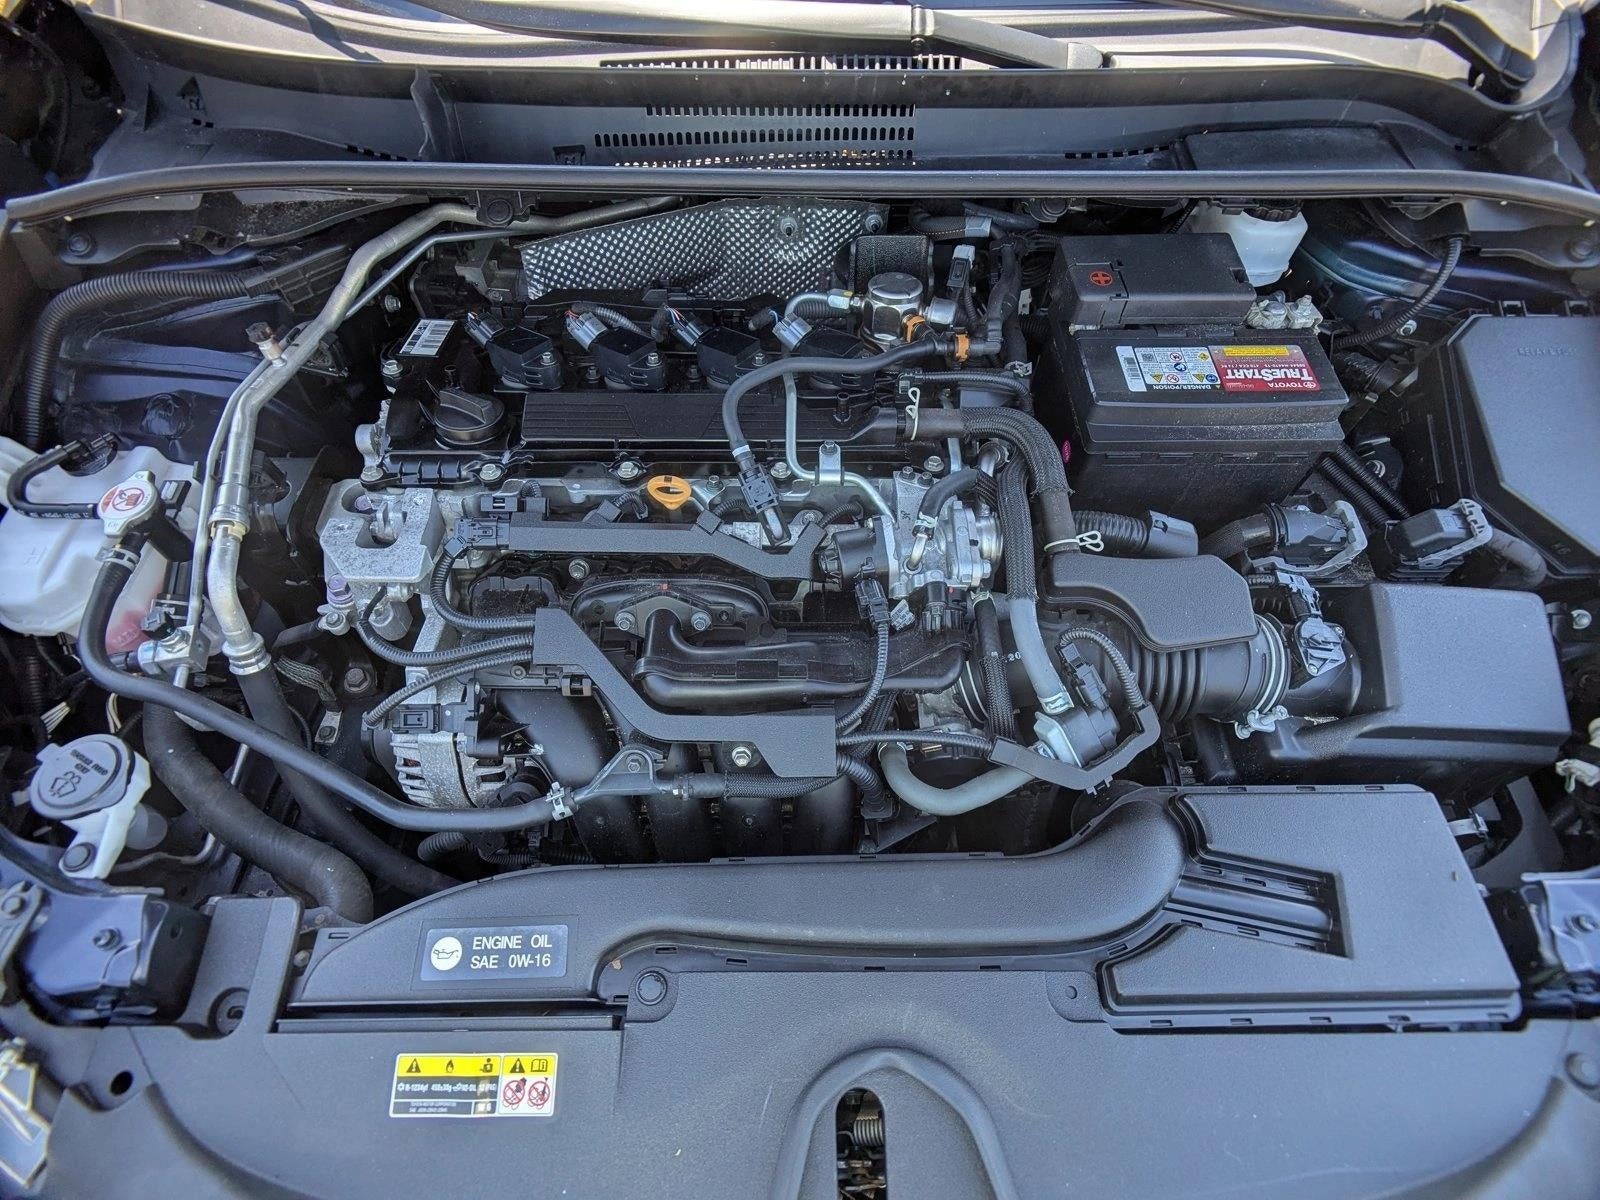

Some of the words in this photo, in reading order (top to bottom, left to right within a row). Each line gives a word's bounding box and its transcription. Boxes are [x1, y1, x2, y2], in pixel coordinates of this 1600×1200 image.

[472, 935, 522, 950] ENGINE
[530, 934, 553, 948] OIL
[470, 954, 499, 969] SAE
[508, 953, 551, 968] 0W-16
